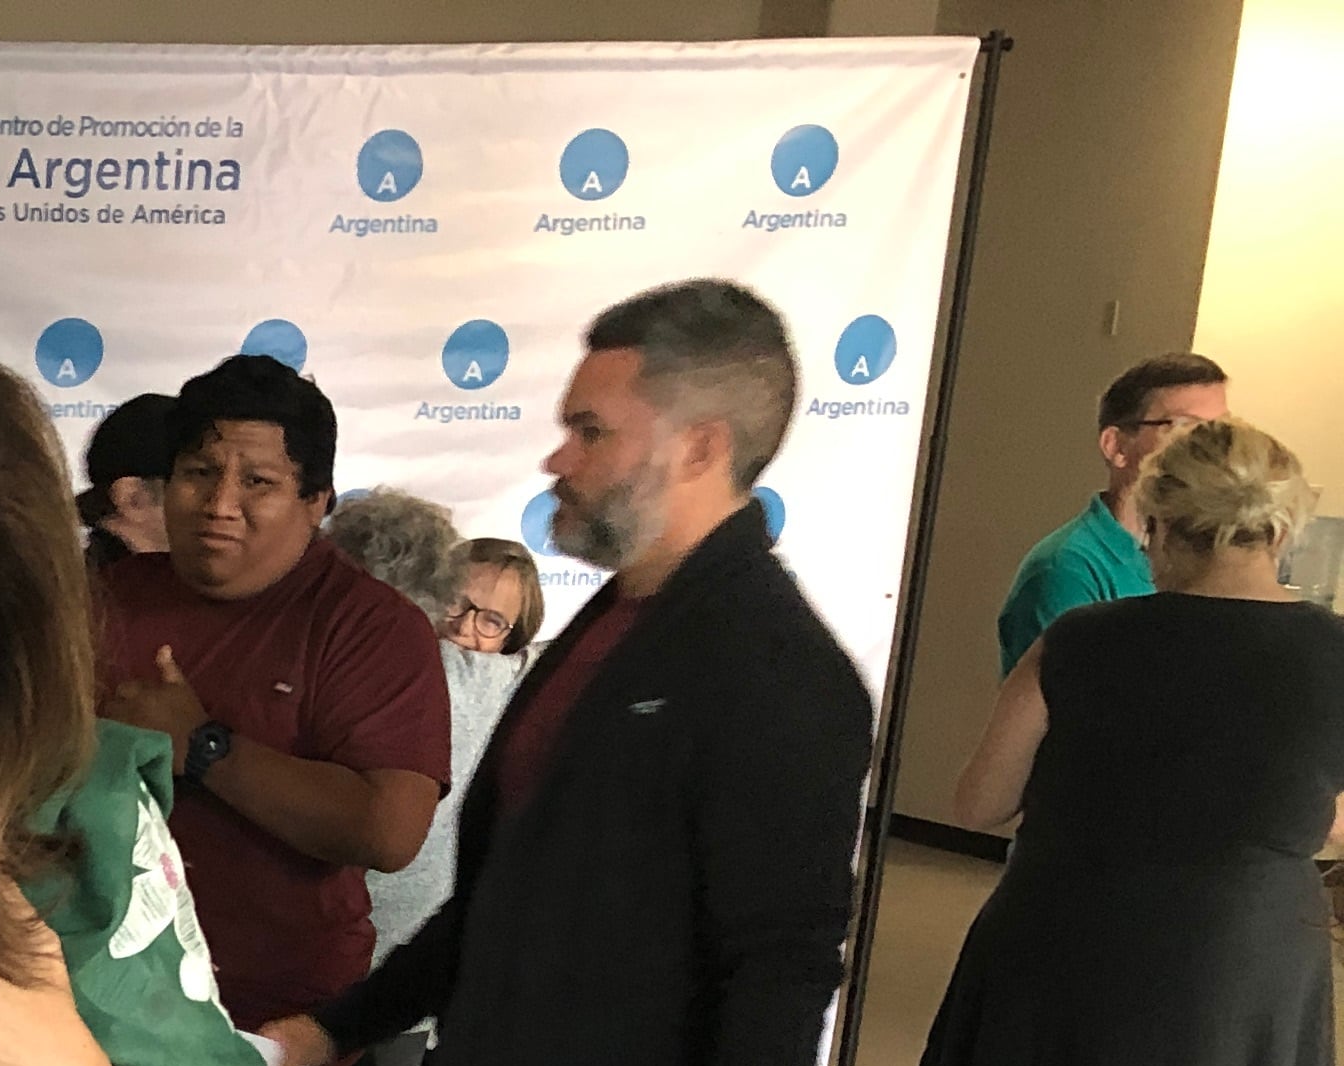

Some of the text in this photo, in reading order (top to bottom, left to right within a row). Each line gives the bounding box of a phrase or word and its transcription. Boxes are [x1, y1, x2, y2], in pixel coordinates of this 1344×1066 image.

[47, 115, 74, 136] de
[79, 115, 190, 138] Promoción
[194, 116, 222, 138] de
[226, 116, 244, 138] la
[6, 148, 240, 198] Argentina
[14, 202, 90, 224] Unidos
[97, 204, 124, 224] de
[131, 204, 226, 224] América
[533, 212, 646, 236] Argentina
[742, 209, 848, 232] Argentina
[328, 214, 438, 237] Argentina
[42, 399, 118, 419] entina
[414, 401, 522, 424] Argentina
[806, 398, 910, 420] Argentina
[537, 570, 602, 586] entina
